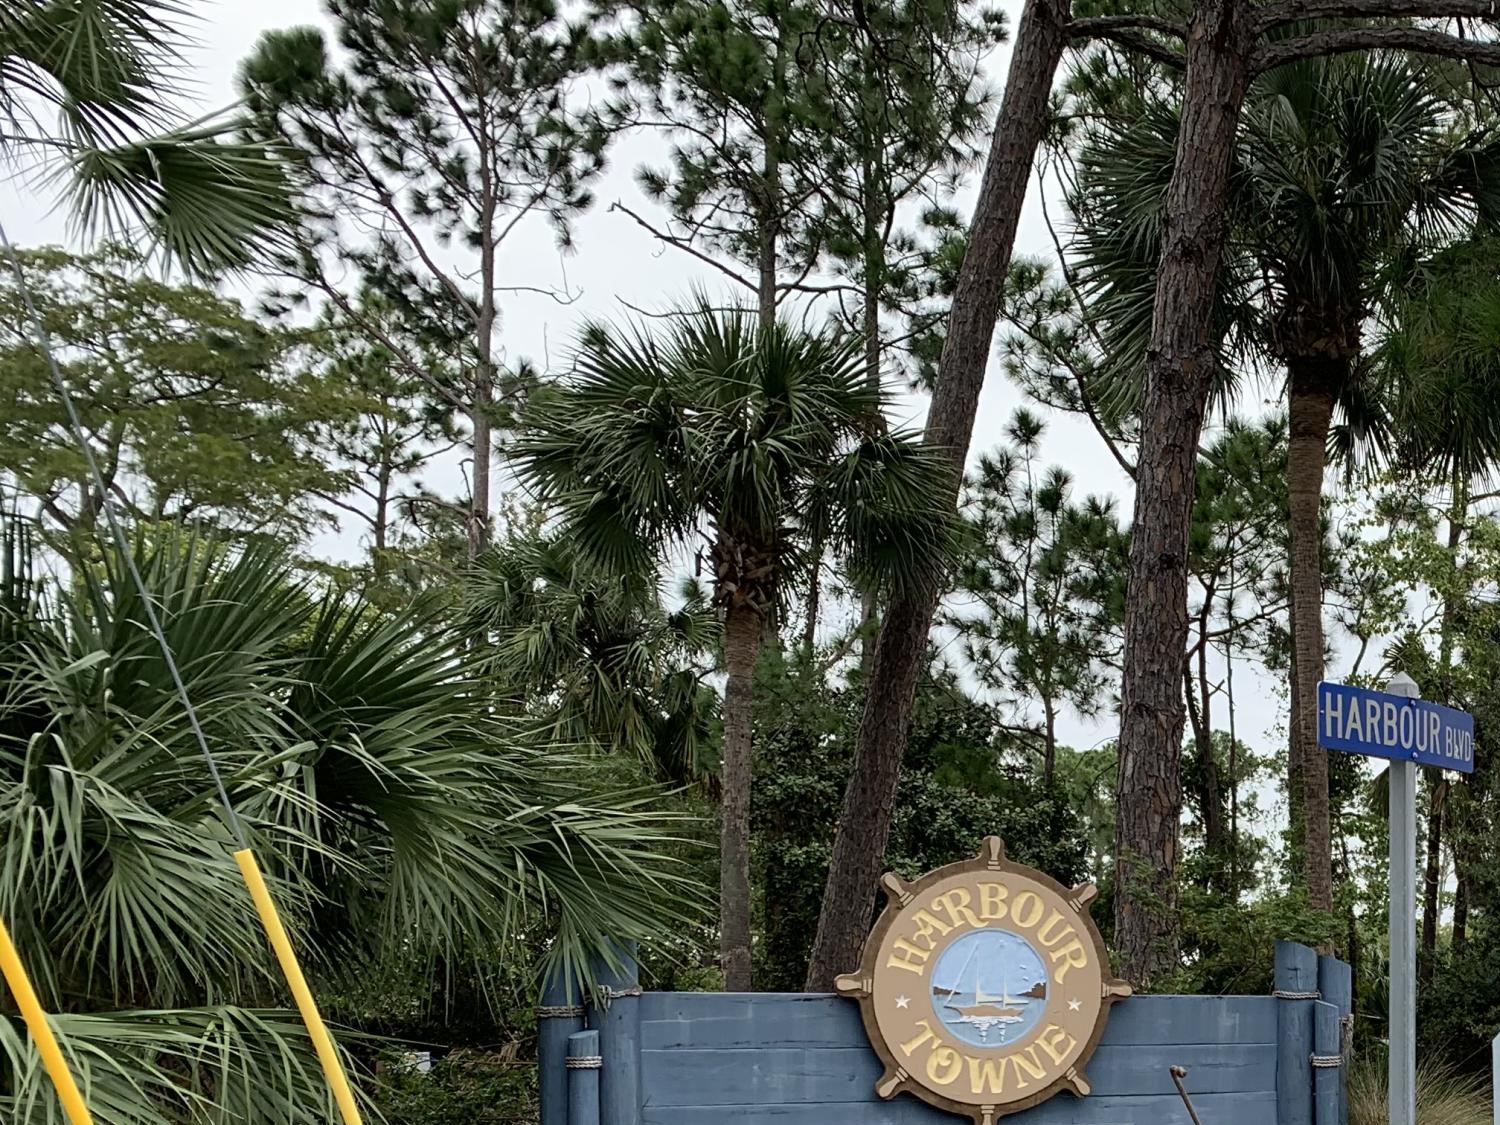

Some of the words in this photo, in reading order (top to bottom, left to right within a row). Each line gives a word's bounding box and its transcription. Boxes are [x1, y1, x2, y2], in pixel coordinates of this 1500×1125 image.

[1325, 692, 1441, 756] HARBOUR
[1445, 726, 1472, 762] BLVD
[886, 881, 1088, 985] HARBOUR
[900, 1018, 1078, 1095] TOWNE
